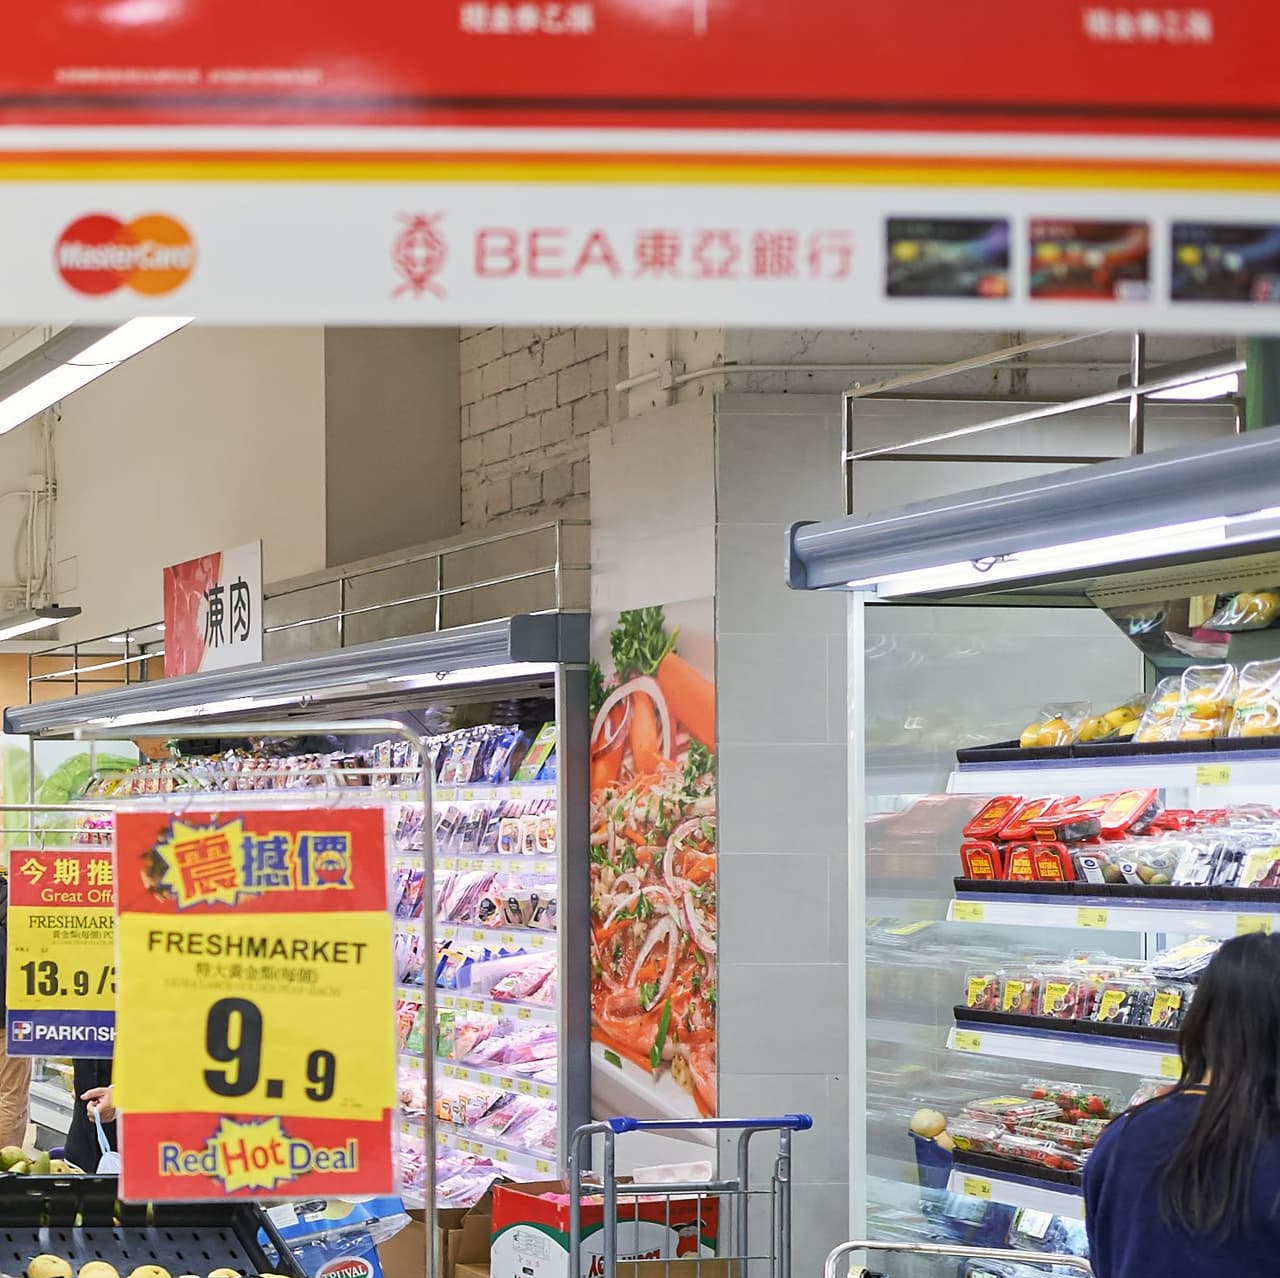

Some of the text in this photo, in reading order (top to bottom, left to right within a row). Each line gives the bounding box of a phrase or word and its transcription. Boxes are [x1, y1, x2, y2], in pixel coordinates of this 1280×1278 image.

[58, 240, 192, 272] MasterCard
[474, 227, 853, 281] BEA 東亞銀行
[203, 576, 251, 648] 凍肉
[41, 888, 83, 903] Great
[148, 930, 368, 964] FRESHMARKET
[203, 997, 337, 1103] 9.9
[161, 1138, 357, 1176] Red Hot Deal
